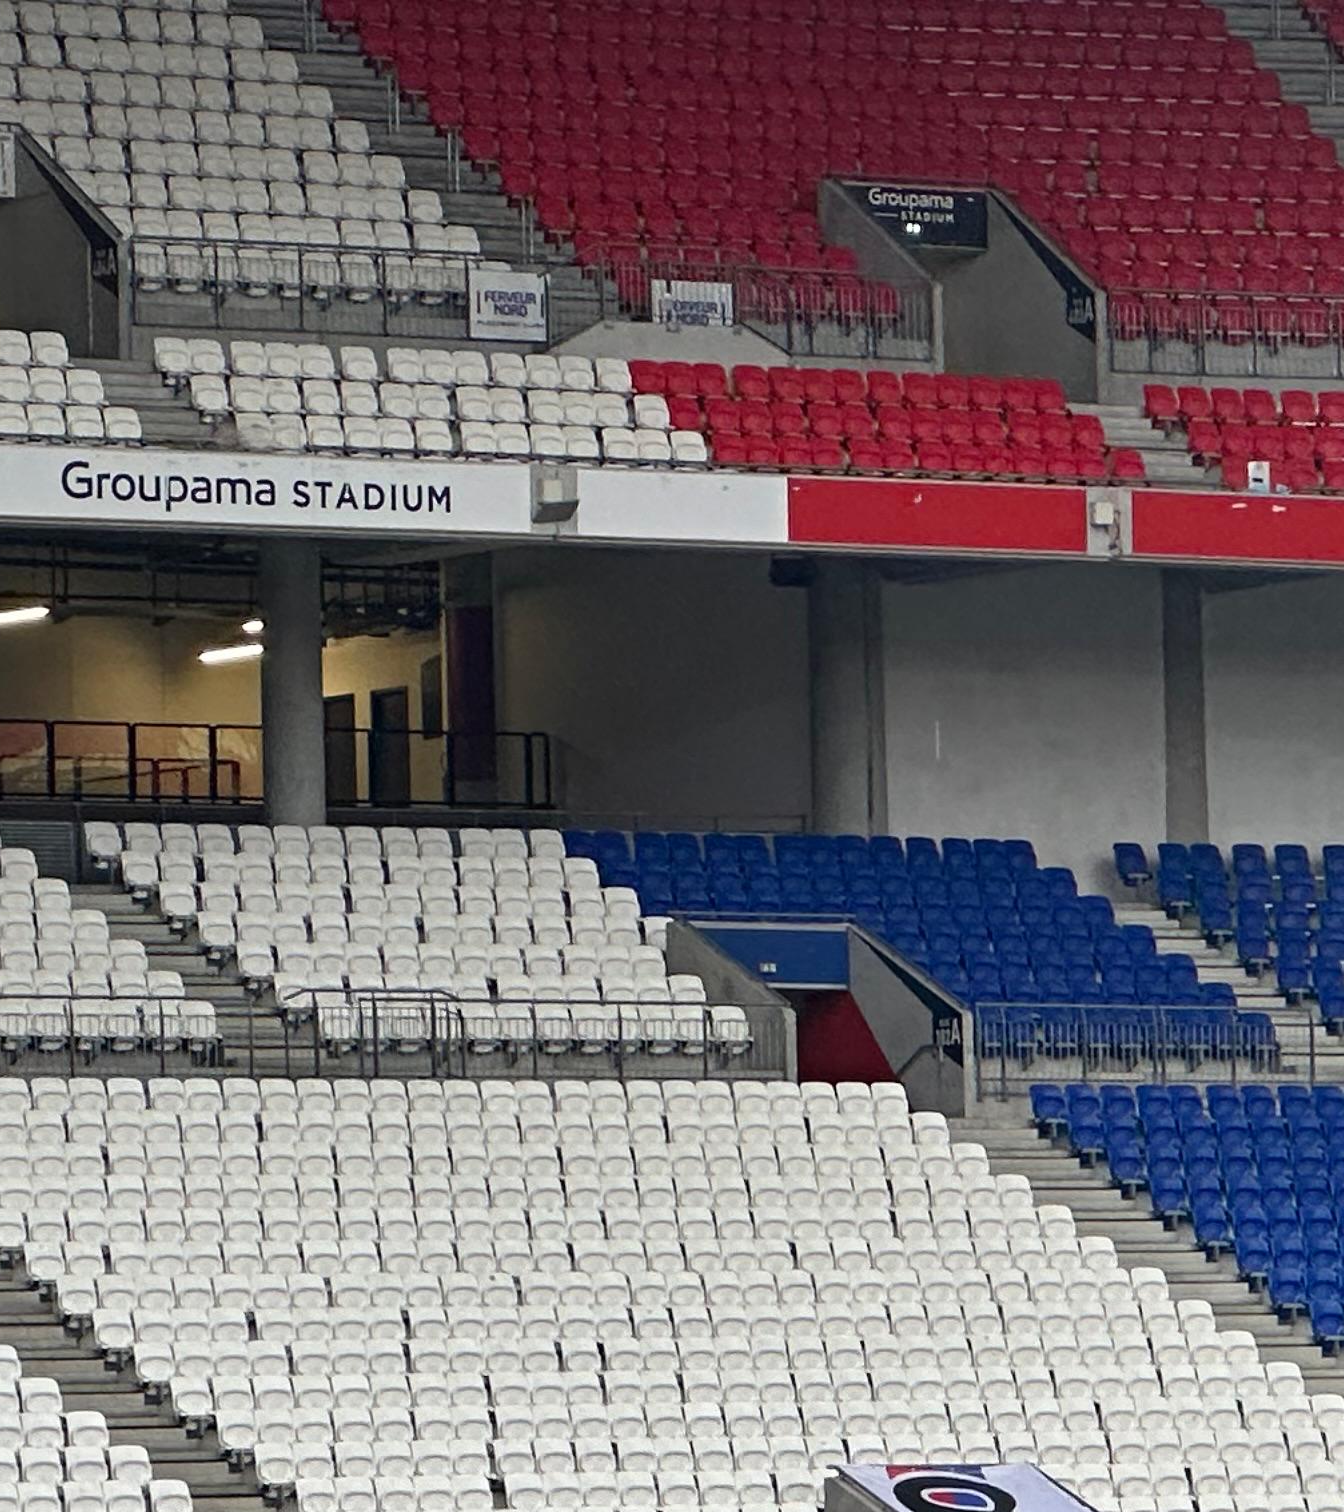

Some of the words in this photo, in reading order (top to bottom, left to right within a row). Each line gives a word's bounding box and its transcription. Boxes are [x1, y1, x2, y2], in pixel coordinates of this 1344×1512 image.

[868, 187, 954, 210] Groupama
[900, 211, 954, 223] STADIUM
[484, 289, 537, 305] FERVEUR
[493, 303, 529, 317] NORD
[60, 460, 277, 512] Groupama
[291, 479, 452, 513] STADIUM
